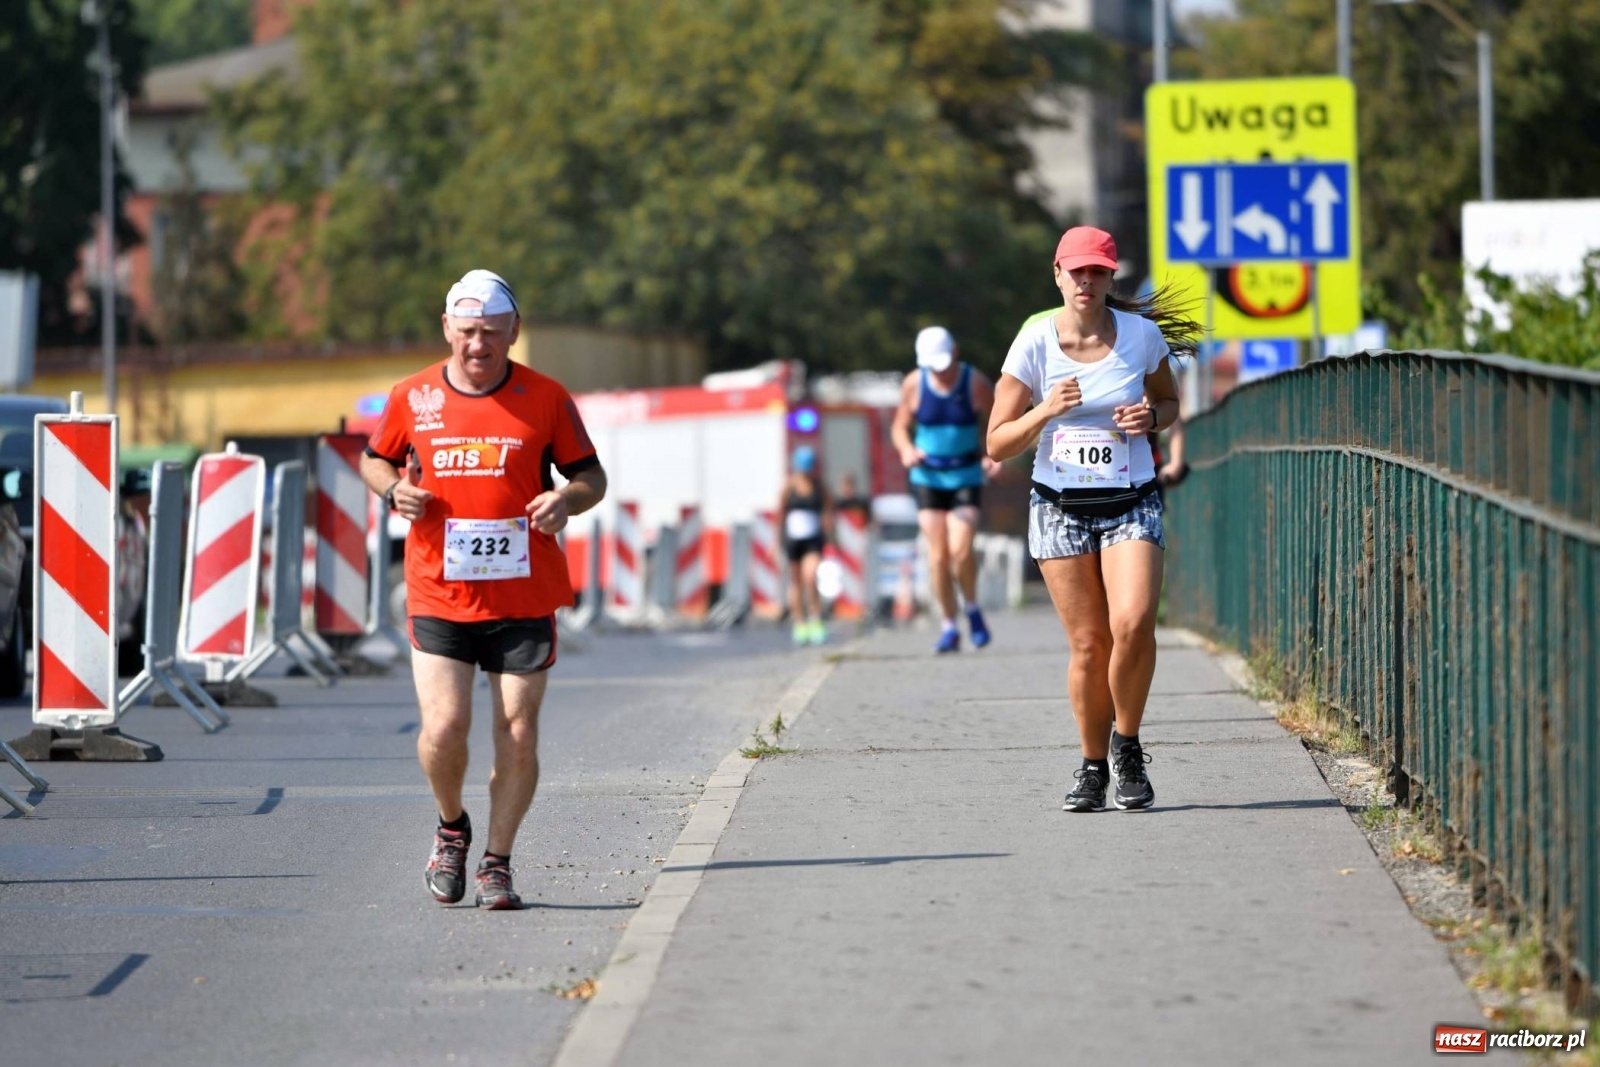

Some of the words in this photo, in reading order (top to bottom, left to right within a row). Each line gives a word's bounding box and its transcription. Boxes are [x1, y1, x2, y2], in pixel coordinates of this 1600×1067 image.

[1170, 96, 1330, 141] Uwaga
[414, 421, 444, 432] POLSKA
[431, 438, 482, 446] ENERGETYKA
[485, 437, 522, 446] SOLARNA
[1078, 446, 1112, 465] 108
[435, 469, 505, 477] www.ensol.pl
[471, 537, 510, 556] 232
